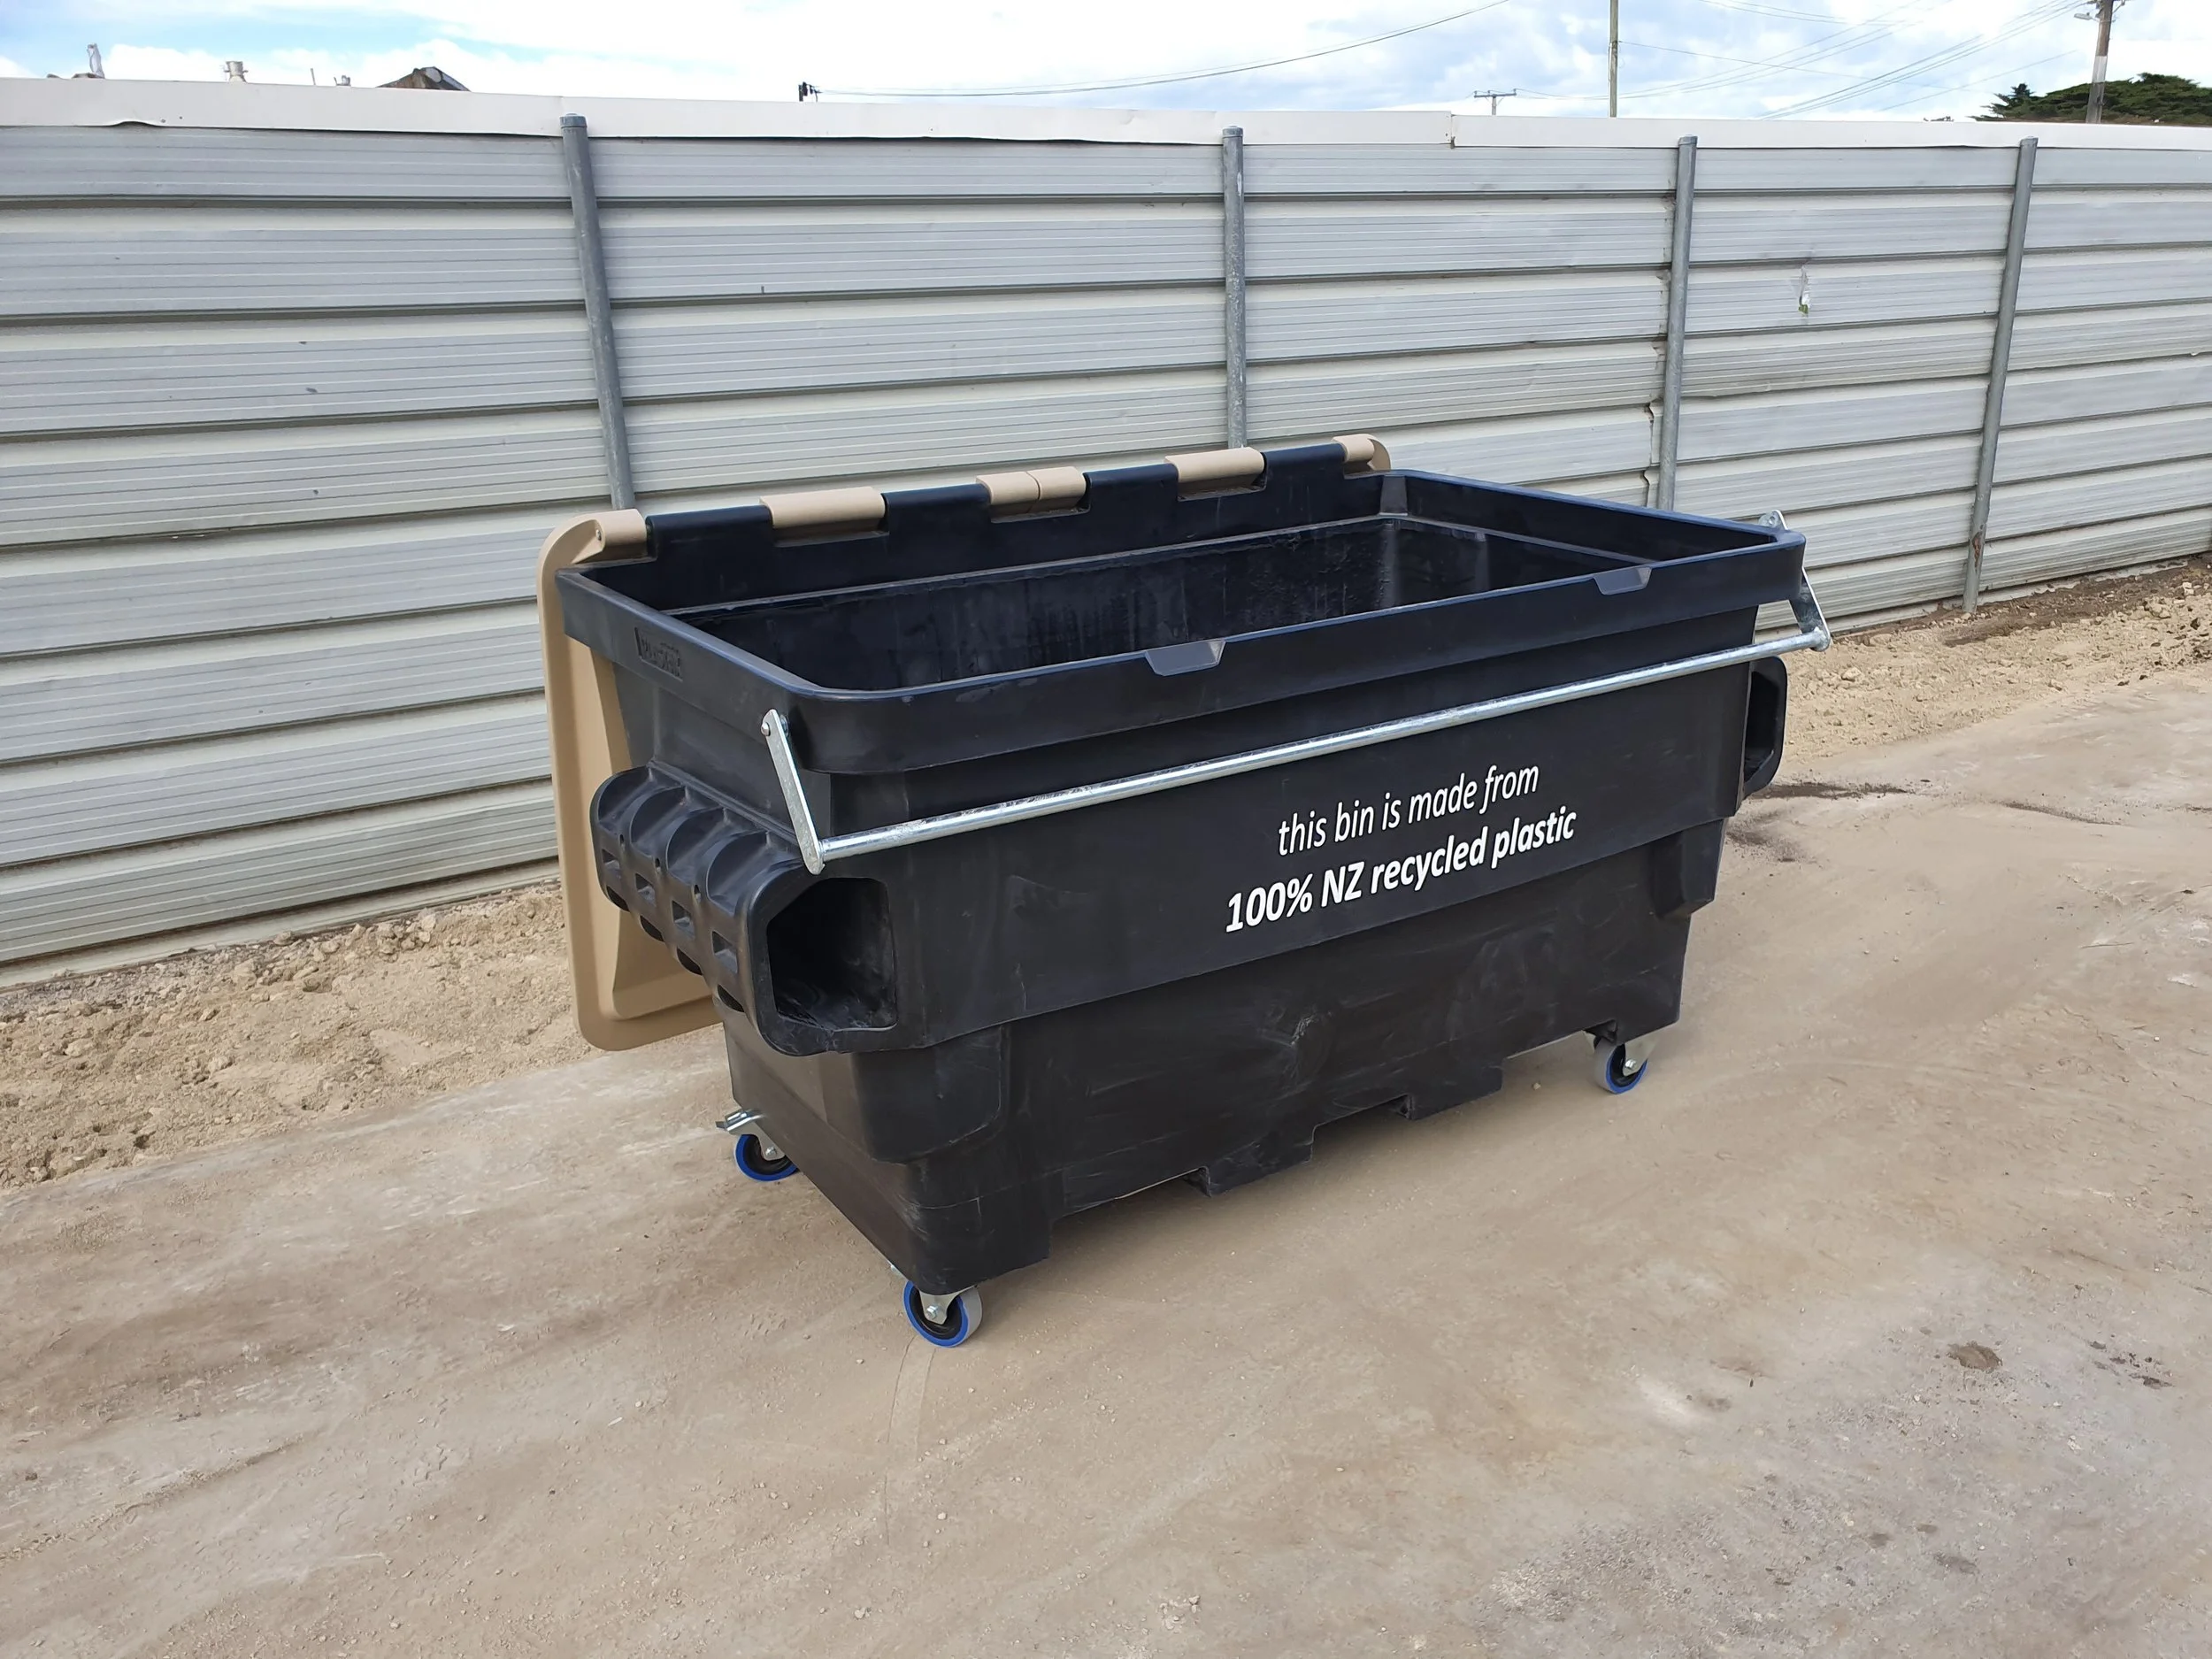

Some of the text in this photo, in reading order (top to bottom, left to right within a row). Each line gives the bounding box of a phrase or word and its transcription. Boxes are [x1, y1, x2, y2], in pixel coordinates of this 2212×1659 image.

[1279, 764, 1540, 856] this bin is made from
[1225, 805, 1577, 933] 100% NZ recycled plastic
